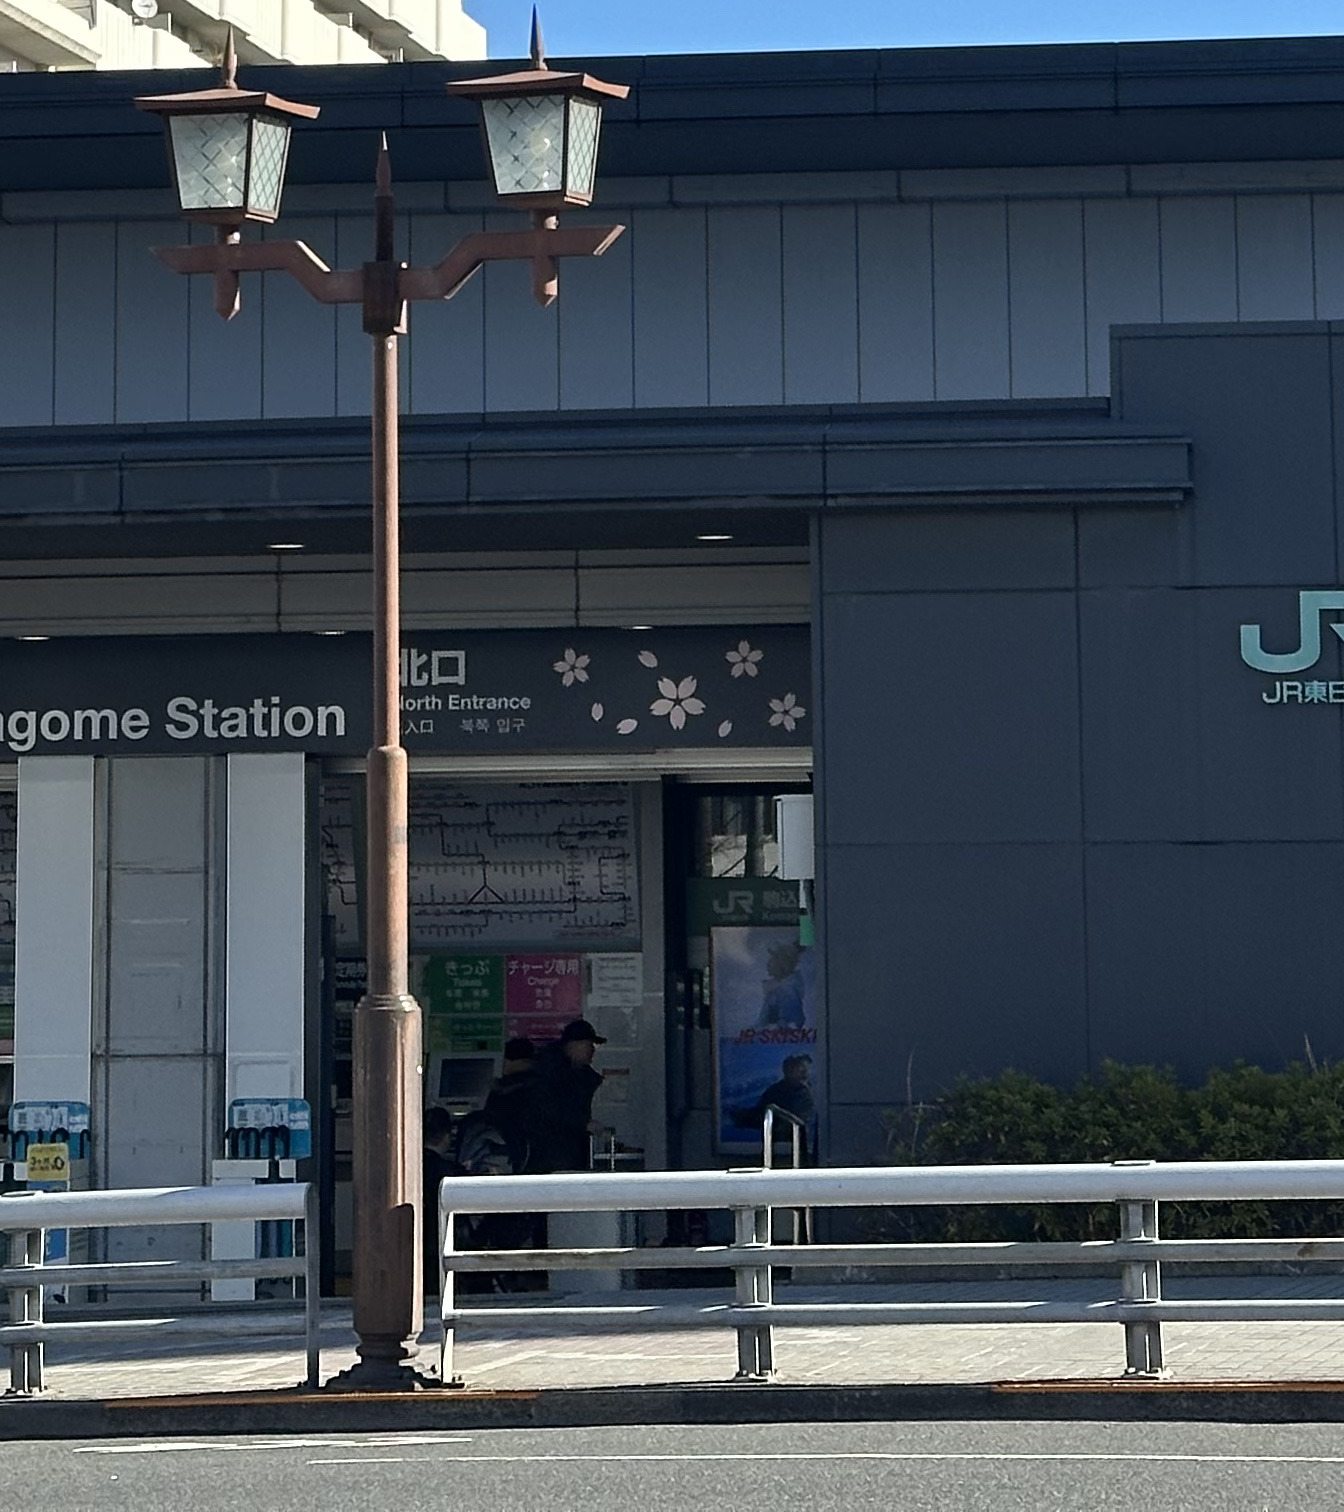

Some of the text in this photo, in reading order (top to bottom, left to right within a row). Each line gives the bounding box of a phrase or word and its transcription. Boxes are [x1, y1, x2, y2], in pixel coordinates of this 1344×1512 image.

[400, 647, 466, 687] 北口
[400, 693, 532, 711] orth Entrance
[164, 696, 346, 740] Station
[401, 719, 434, 735] 入口
[445, 960, 491, 976] きっぷ
[508, 959, 580, 976] チャージ専用
